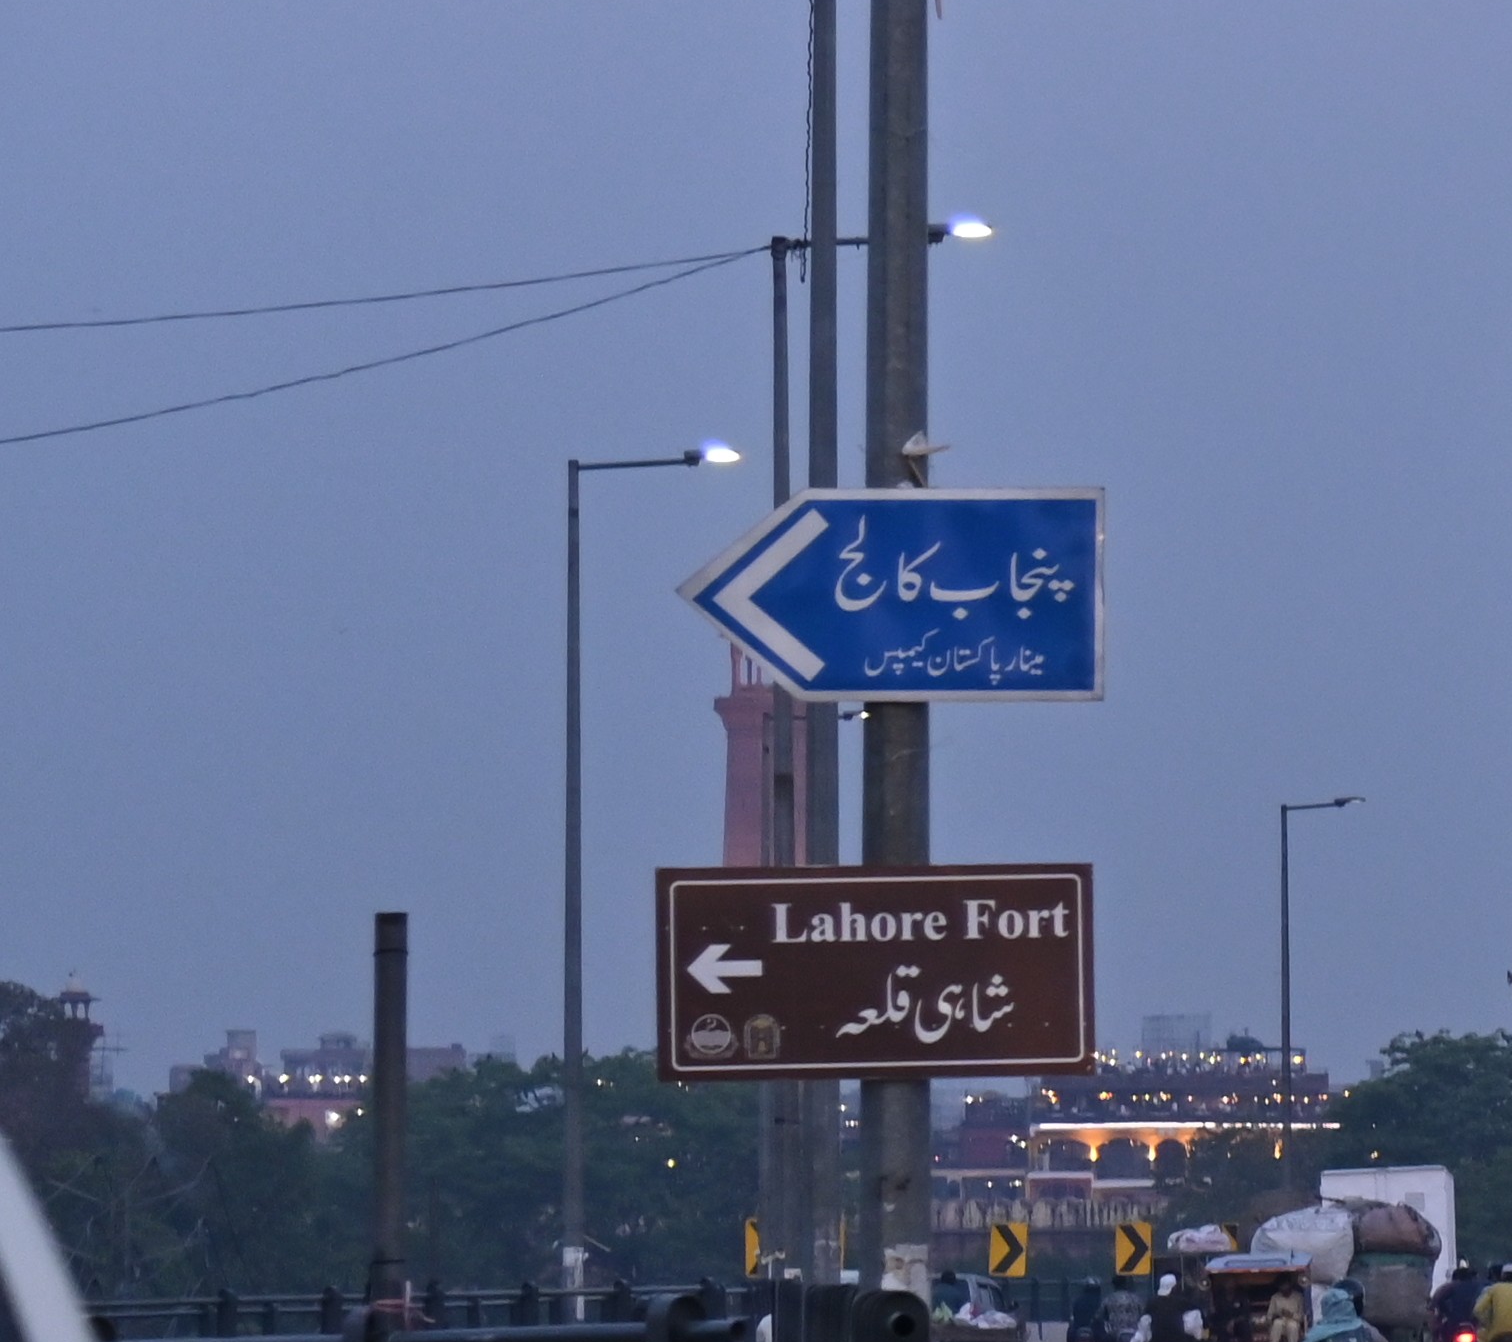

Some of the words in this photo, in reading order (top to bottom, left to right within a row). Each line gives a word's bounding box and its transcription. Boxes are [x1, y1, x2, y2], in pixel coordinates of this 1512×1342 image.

[834, 515, 941, 612] کالج
[929, 548, 1075, 620] پنجاب
[864, 628, 940, 677] کیمپس
[926, 636, 1001, 686] پاکستان
[1004, 645, 1045, 676] مینار
[771, 901, 947, 944] Lahore
[963, 899, 1070, 940] Fort
[835, 964, 921, 1038] قلعہ
[914, 973, 1015, 1044] شاہی
